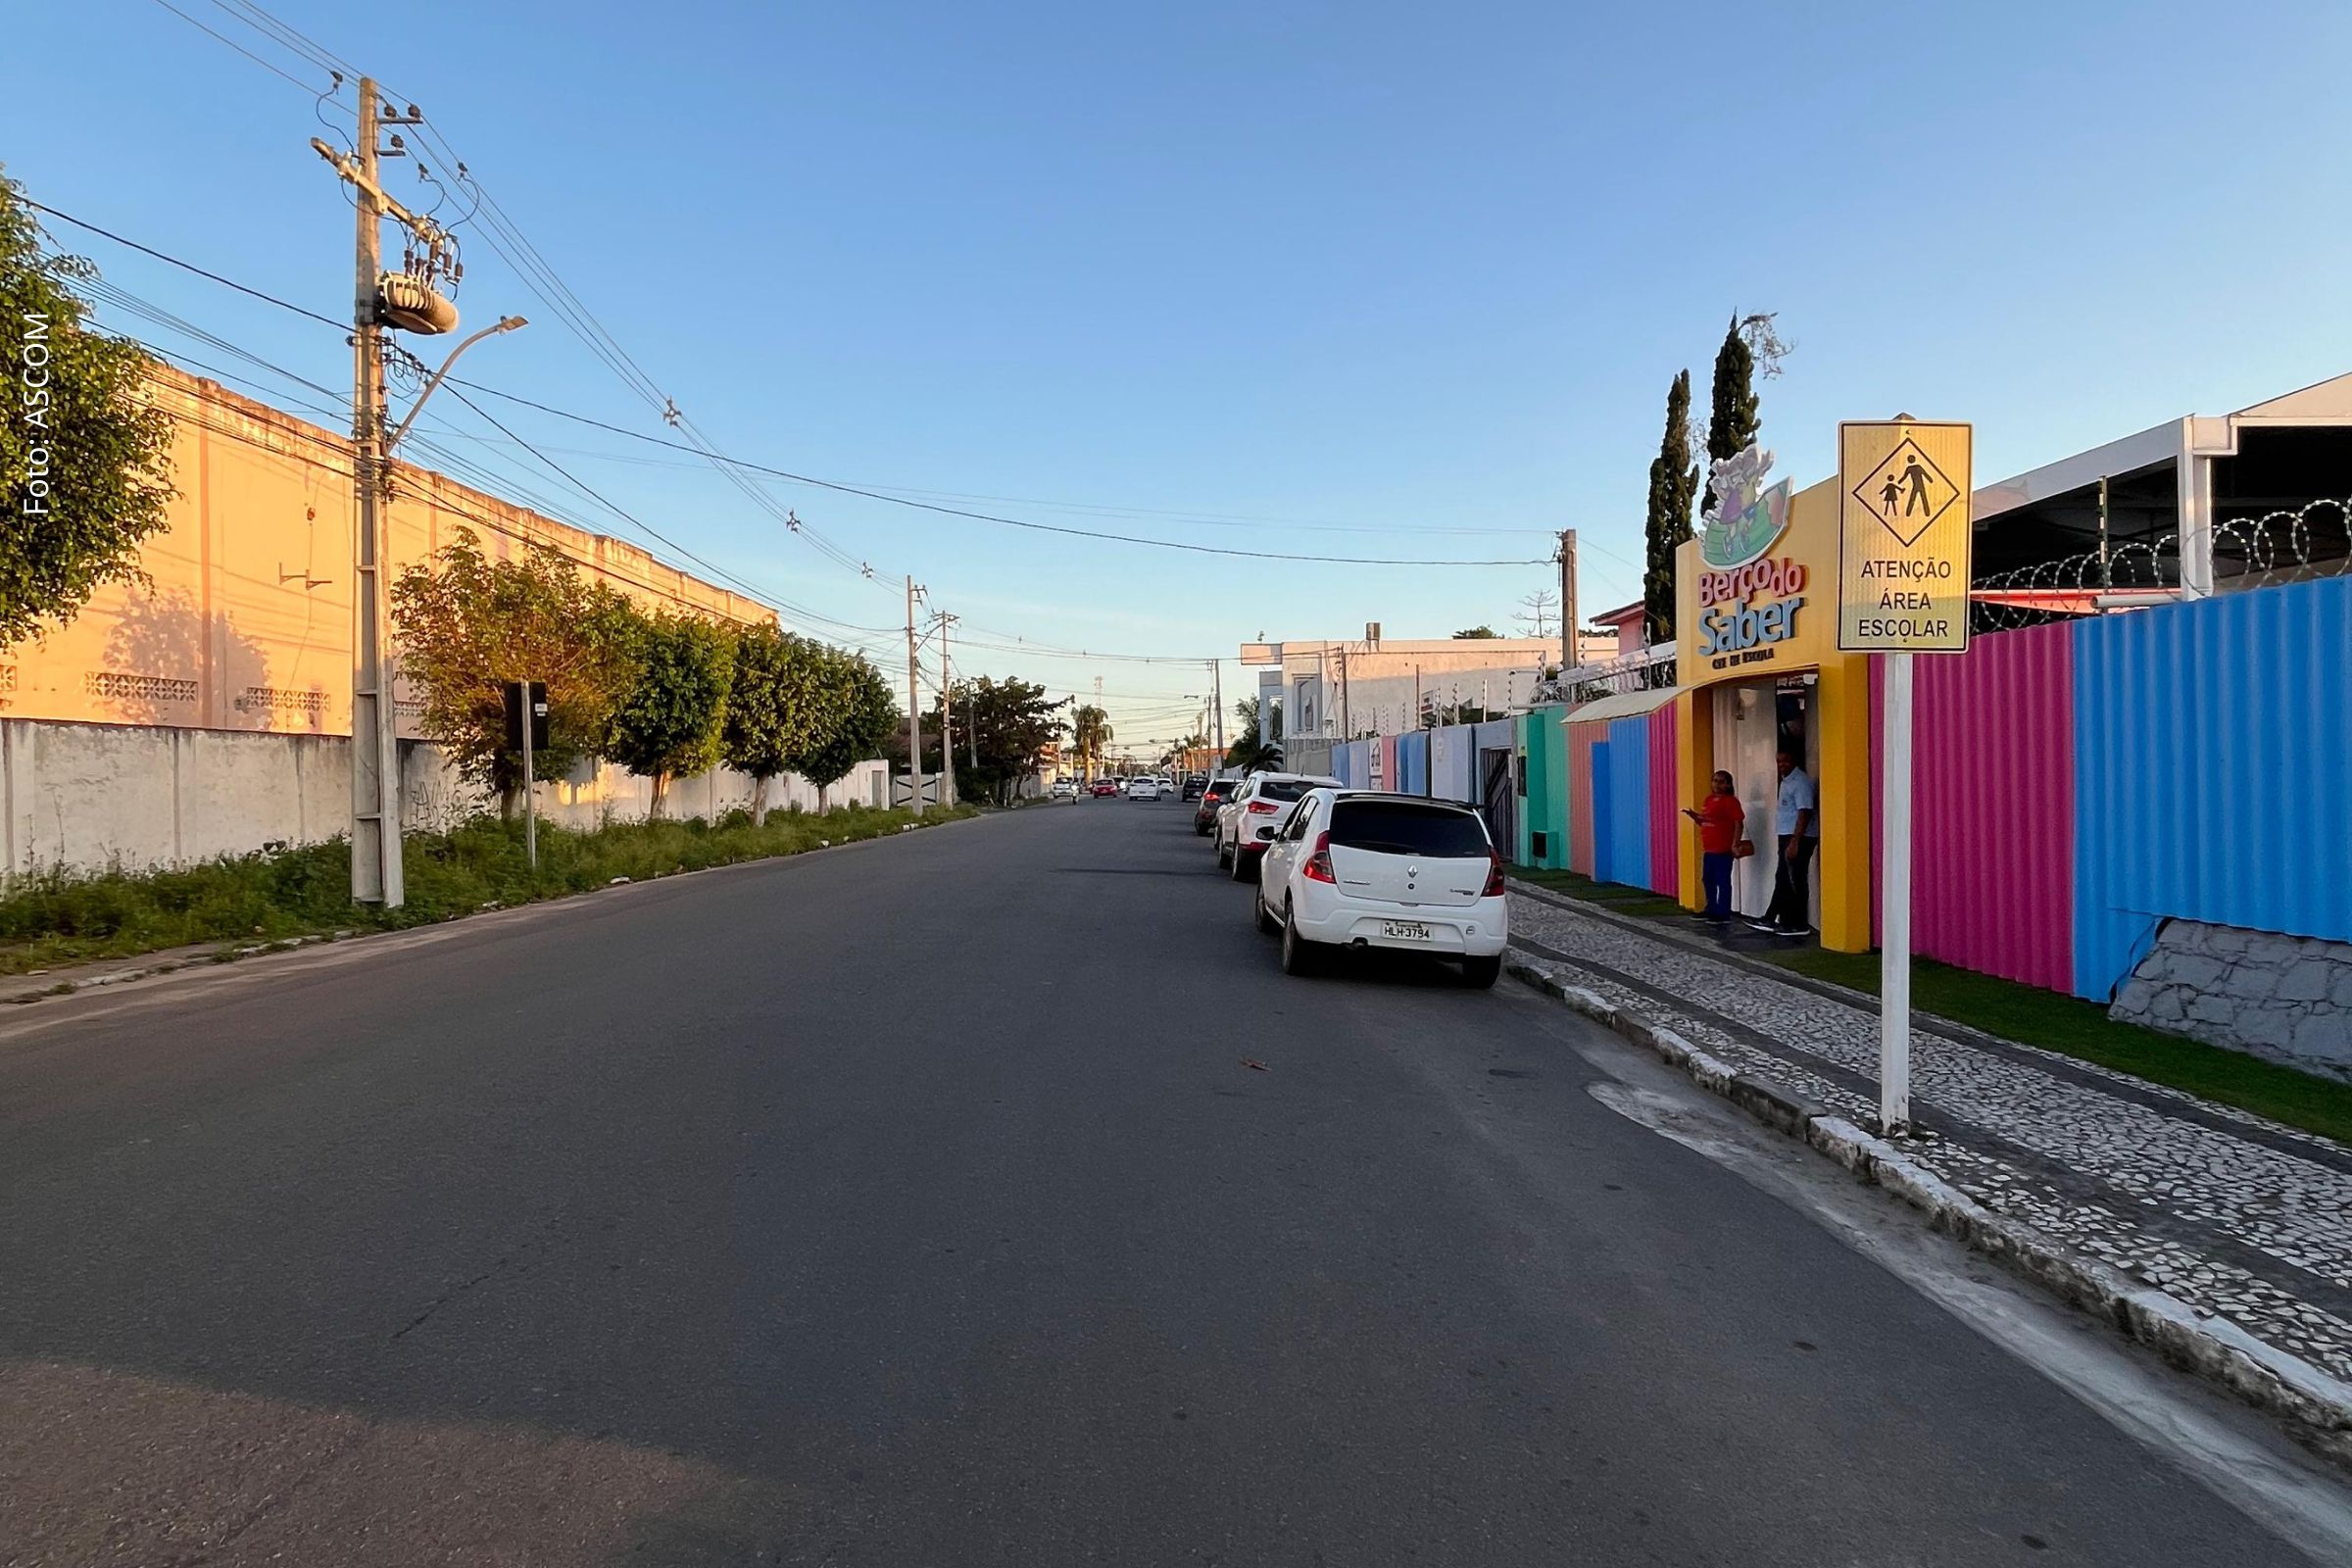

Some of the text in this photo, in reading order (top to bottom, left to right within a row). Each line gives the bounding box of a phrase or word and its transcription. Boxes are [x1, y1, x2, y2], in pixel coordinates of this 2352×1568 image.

[1698, 557, 1806, 608] Berço do
[1860, 557, 1951, 583] ATENÇÃO
[1879, 587, 1932, 610] ÁREA
[1697, 596, 1804, 657] Saber
[1858, 618, 1948, 638] ESCOLAR
